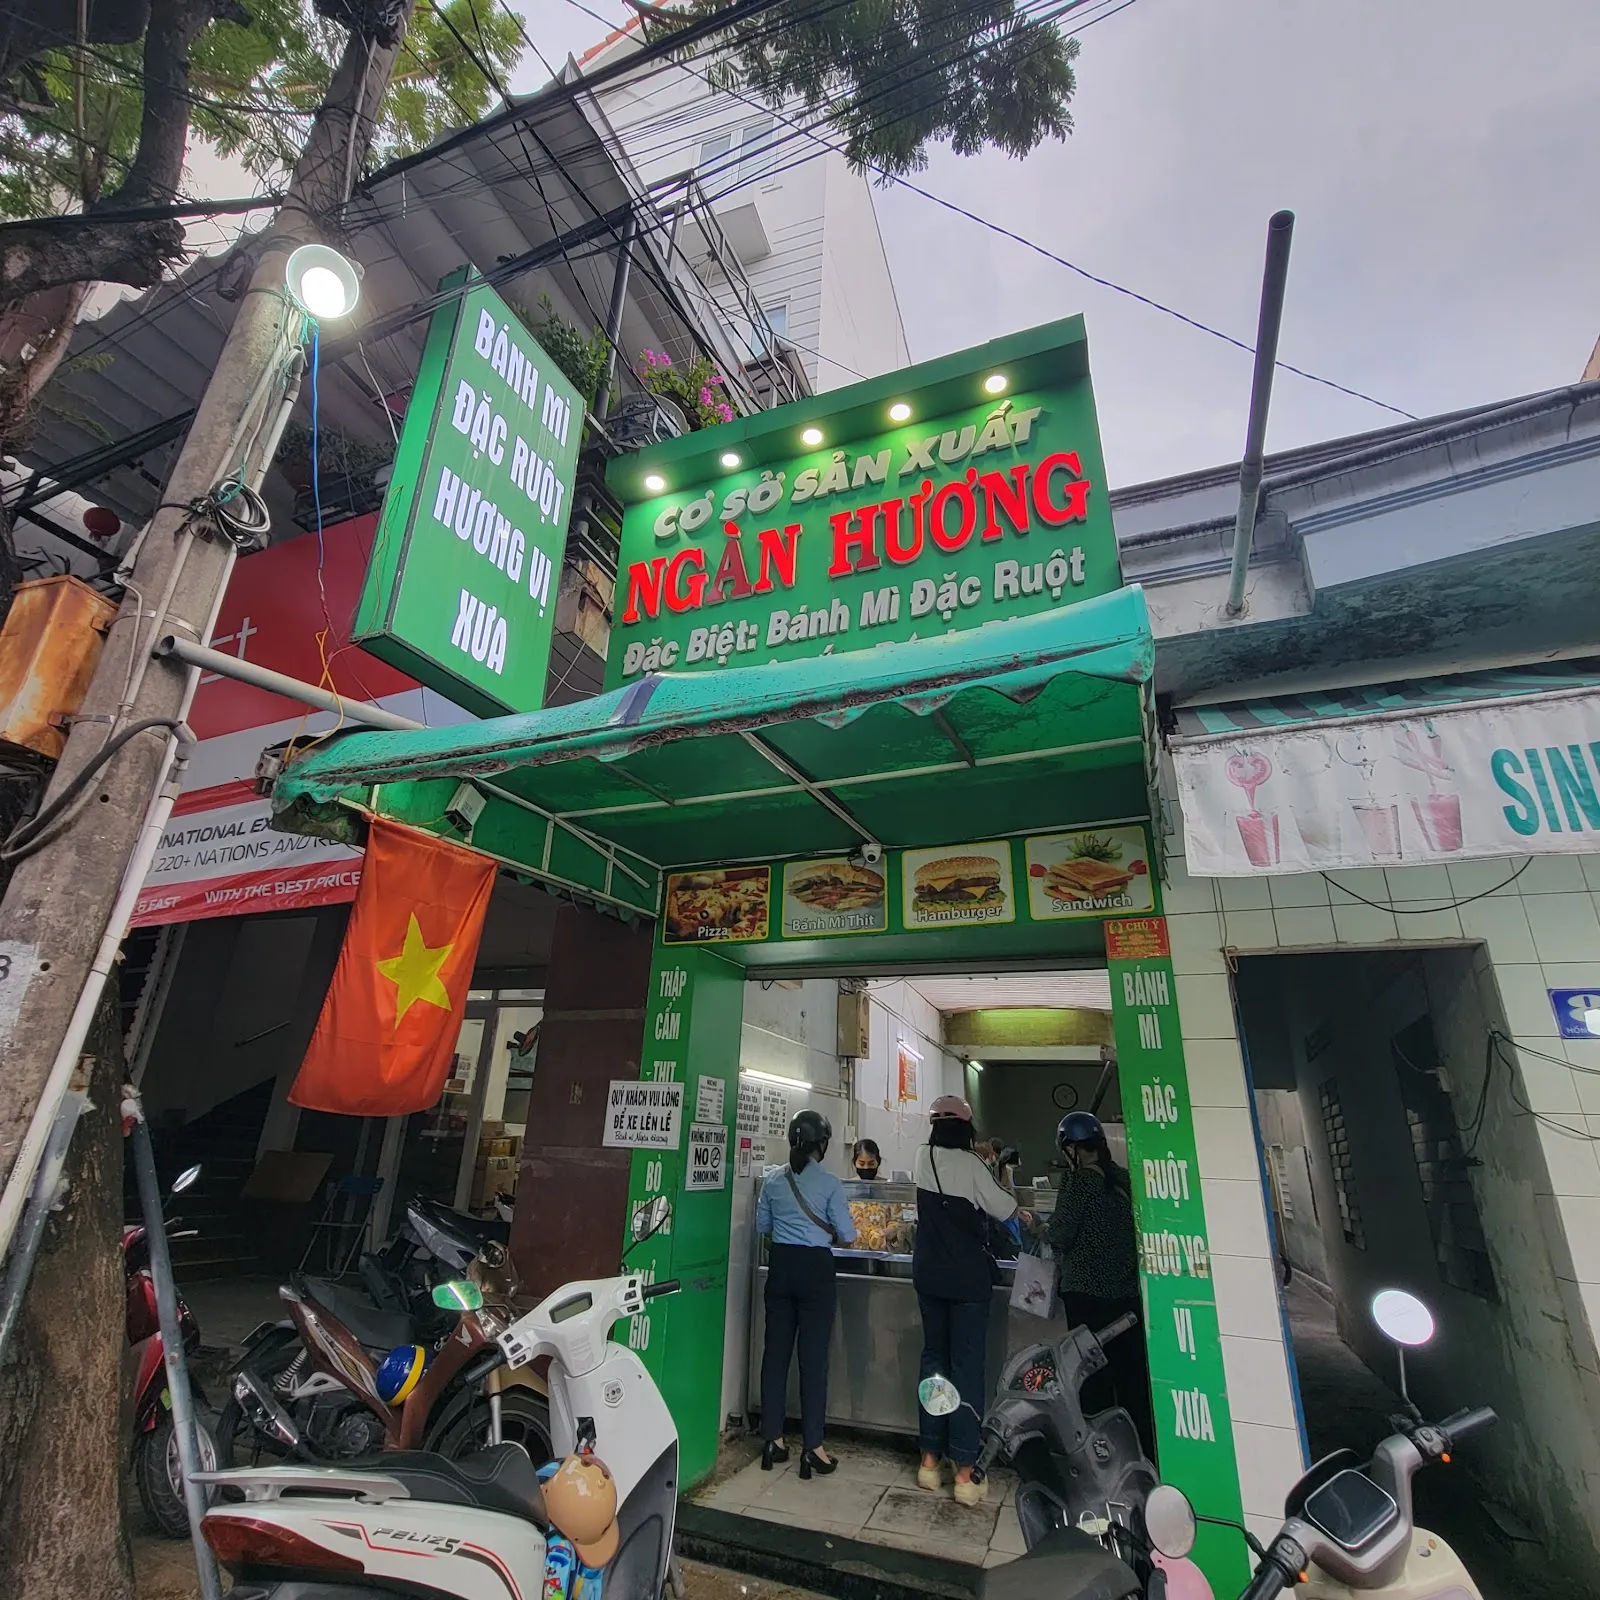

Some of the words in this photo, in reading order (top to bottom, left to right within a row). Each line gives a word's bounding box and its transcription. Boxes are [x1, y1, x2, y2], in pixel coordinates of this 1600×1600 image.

[474, 307, 539, 411] BÁNH
[451, 378, 508, 467] ĐẶC
[510, 434, 565, 526] RUỘT
[653, 490, 714, 540] CƠ
[718, 470, 787, 521] SỞ
[790, 448, 892, 503] SẢN
[898, 399, 1043, 477] XUẤT
[433, 465, 526, 584] HƯƠNG
[529, 545, 553, 618] VỊ
[621, 521, 802, 625] NGÀN
[827, 451, 1092, 578] HƯƠNG
[622, 636, 679, 678] Đặc
[686, 621, 758, 666] Biệt:
[765, 603, 849, 648] Bánh
[858, 585, 901, 629] Mì
[910, 571, 982, 621] Đặc
[993, 546, 1087, 600] Ruột
[450, 587, 508, 676] XƯA
[157, 821, 246, 850] NATIONAL
[250, 817, 273, 834] EX
[154, 854, 191, 873] 220+
[194, 841, 271, 867] NATIONS
[146, 895, 180, 911] FAST
[205, 887, 243, 905] WITH
[242, 883, 274, 902] THE
[274, 878, 314, 896] BEST
[917, 905, 1003, 922] Hamburger
[1052, 893, 1133, 913] Sandwich
[697, 926, 728, 937] Pizza
[792, 918, 825, 931] Bánh
[828, 914, 846, 929] Mì
[848, 913, 875, 930] Thịt
[660, 965, 687, 1001] THẬP
[1122, 965, 1170, 1006] BÁNH
[1137, 1007, 1162, 1049] MÌ
[611, 1085, 625, 1108] QUÝ
[625, 1086, 648, 1106] KHÁCH
[649, 1090, 661, 1106] VUI
[661, 1087, 680, 1108] LÒNG
[1140, 1077, 1178, 1129] ĐẶC
[627, 1114, 638, 1130] XE
[640, 1112, 658, 1131] LÊN
[694, 1147, 709, 1166] NO
[692, 1170, 719, 1183] SMOKING
[1143, 1151, 1190, 1208] RUỘT
[1173, 1308, 1196, 1360] VỊ
[1171, 1387, 1216, 1442] XƯA
[372, 1527, 446, 1546] FELIZ
